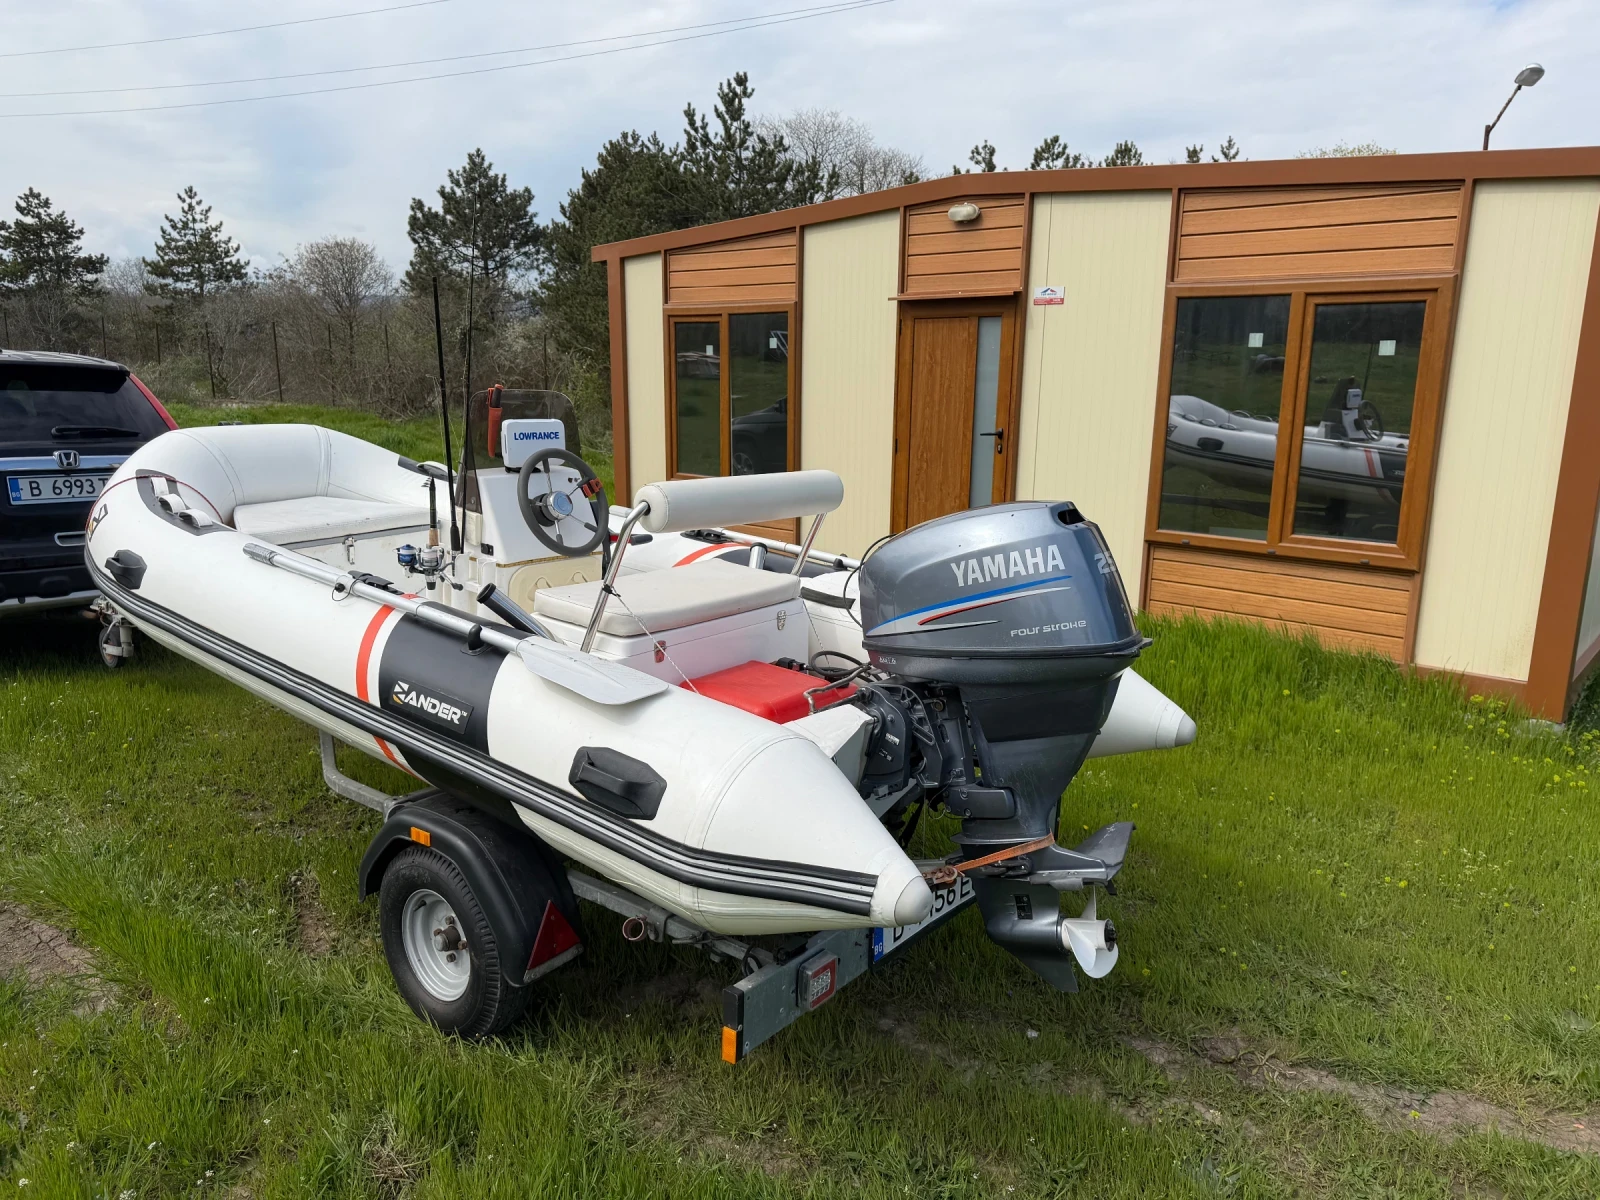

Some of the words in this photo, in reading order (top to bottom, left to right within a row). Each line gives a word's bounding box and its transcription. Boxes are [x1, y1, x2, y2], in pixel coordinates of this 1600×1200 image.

[513, 431, 560, 441] LOWRANCE
[28, 480, 42, 497] B
[52, 478, 96, 496] 6993
[950, 544, 1066, 588] YAMAHA
[1010, 626, 1039, 638] FOUR
[1042, 619, 1087, 634] STROKE
